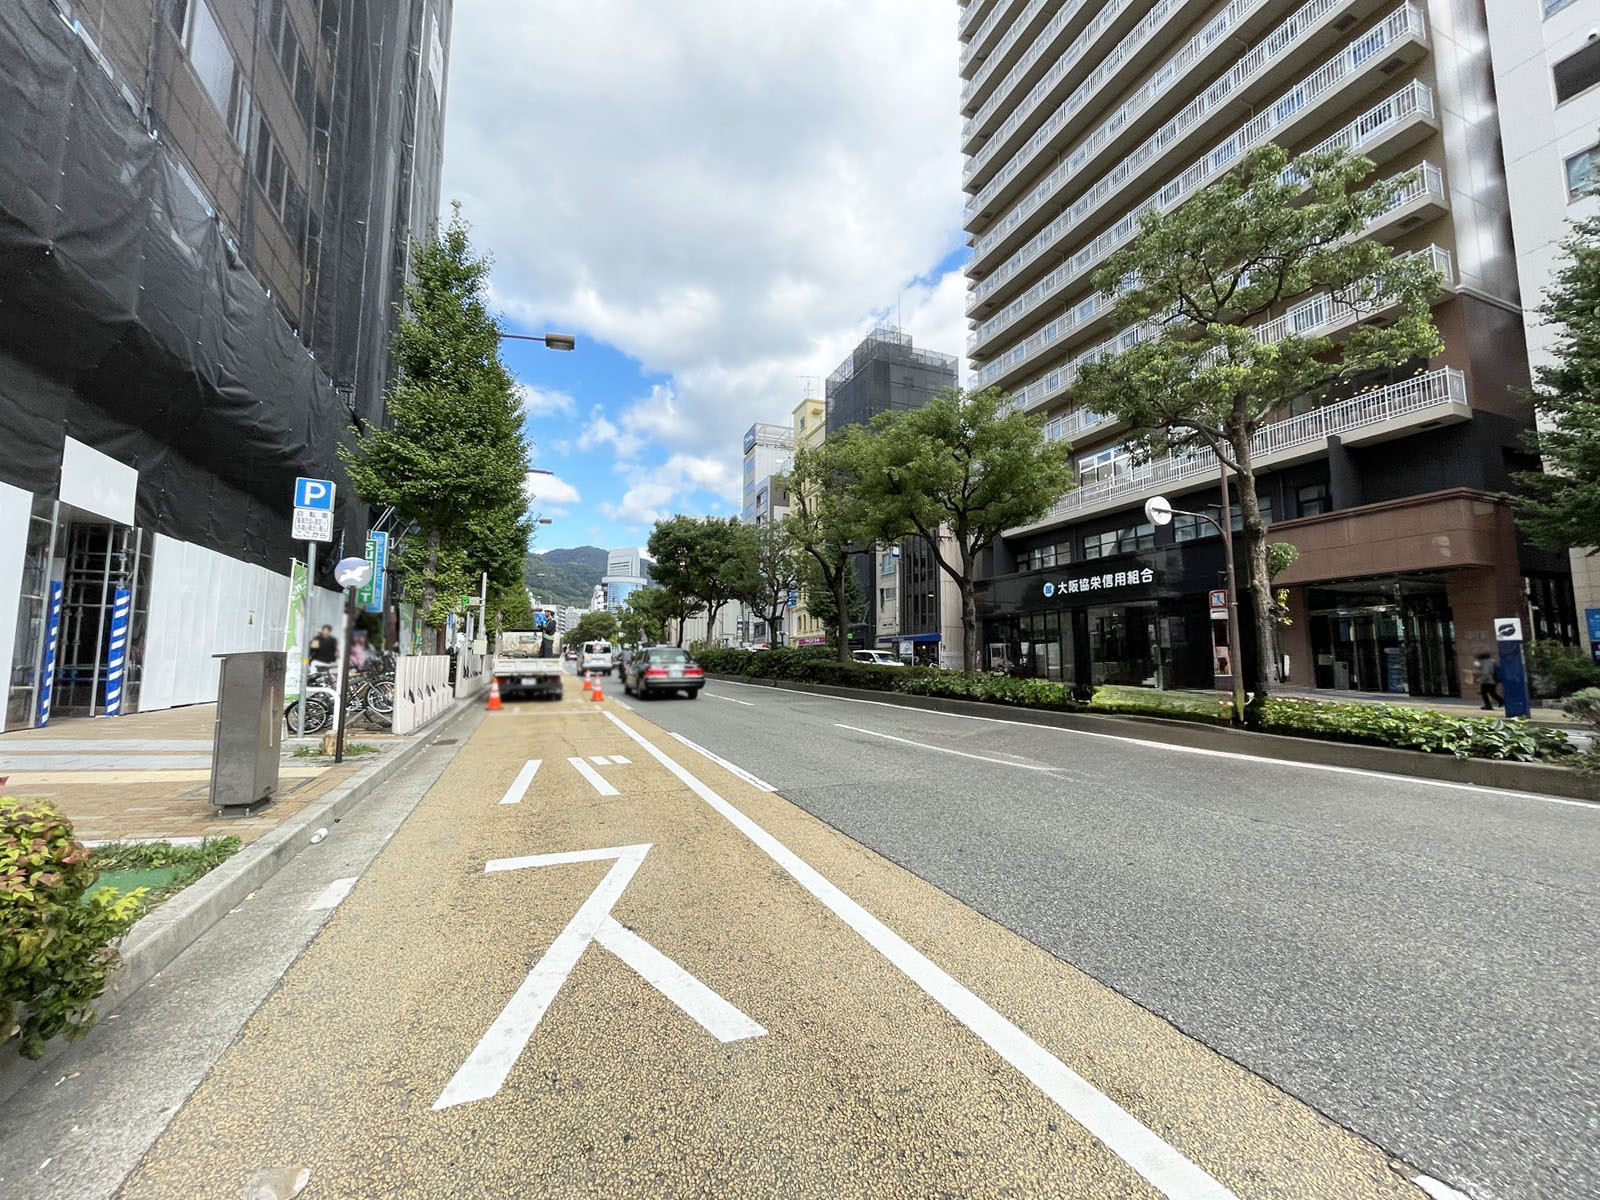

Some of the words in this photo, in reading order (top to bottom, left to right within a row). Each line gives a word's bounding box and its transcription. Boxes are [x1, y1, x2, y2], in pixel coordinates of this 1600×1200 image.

[304, 481, 326, 506] P
[1057, 567, 1154, 595] 大阪協栄信用組合
